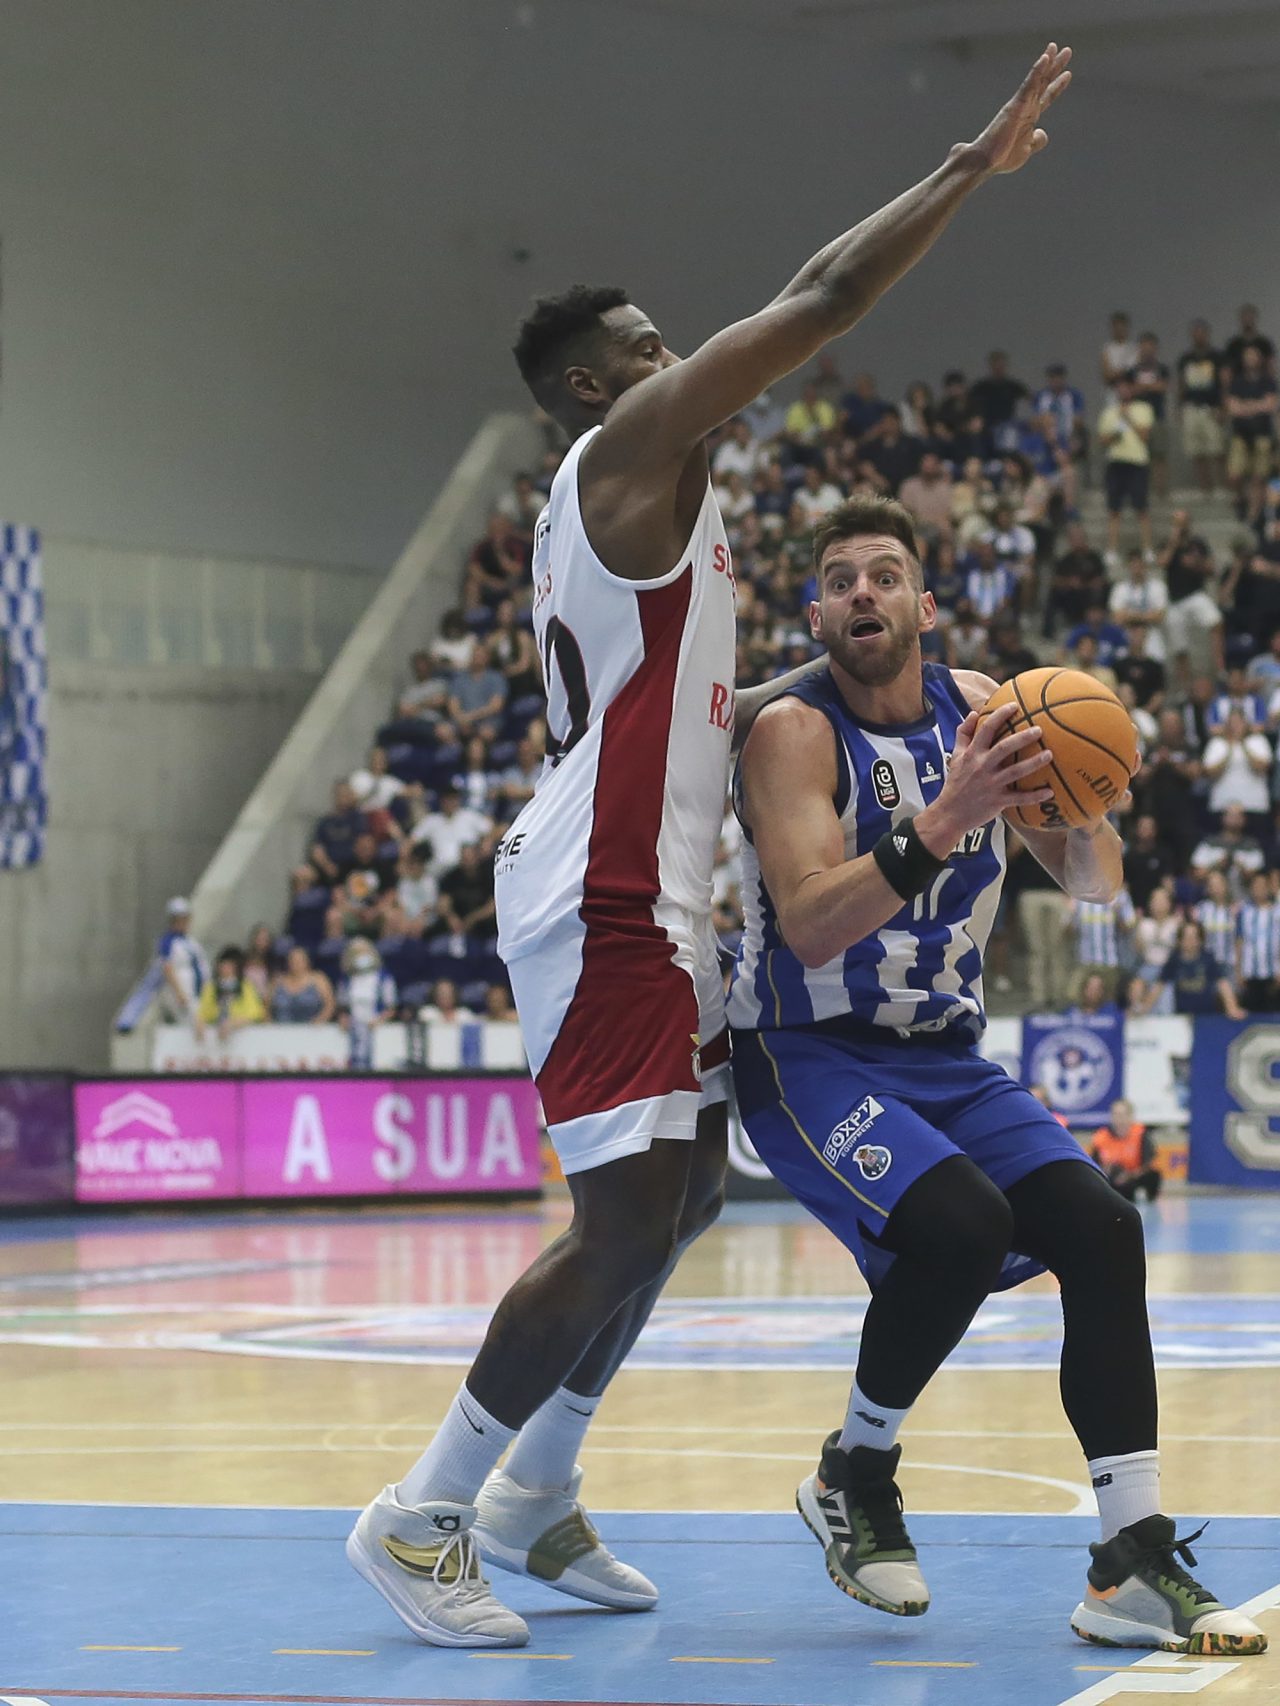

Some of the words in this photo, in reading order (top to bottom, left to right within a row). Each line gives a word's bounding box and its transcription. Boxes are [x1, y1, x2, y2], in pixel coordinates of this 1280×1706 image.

[283, 1092, 333, 1183] A
[370, 1090, 525, 1182] SUA
[826, 1101, 868, 1160] BOXPT
[841, 1120, 875, 1157] EQUIPMENT
